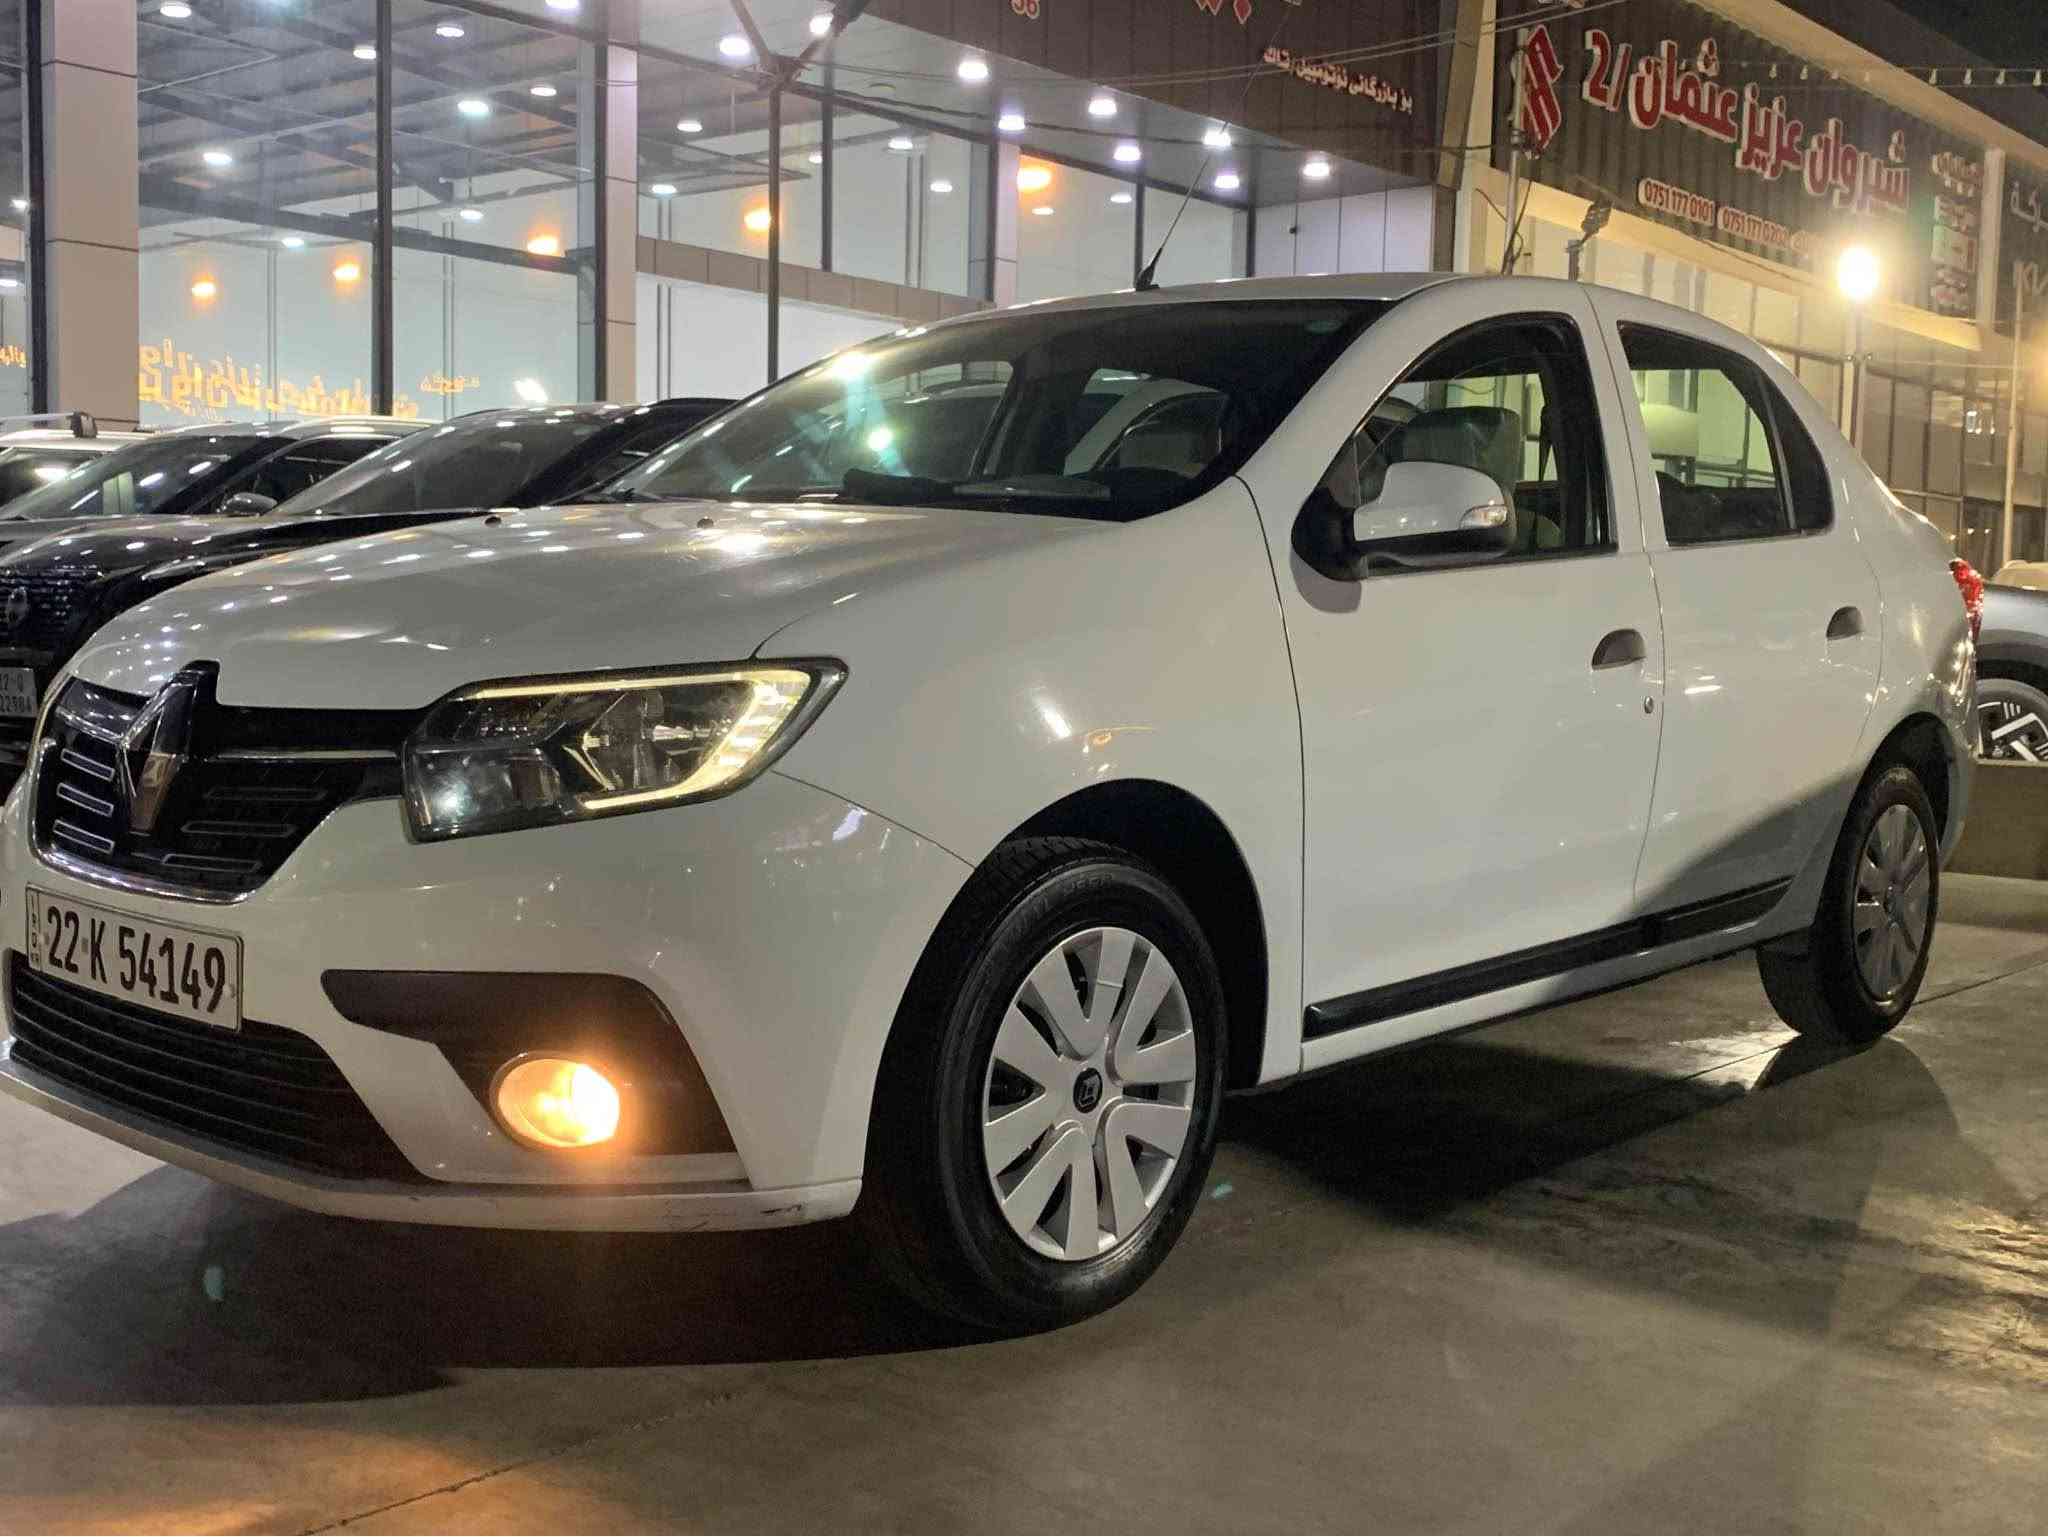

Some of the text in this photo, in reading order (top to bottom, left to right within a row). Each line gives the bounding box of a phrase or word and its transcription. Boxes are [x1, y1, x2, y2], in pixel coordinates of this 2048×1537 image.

[47, 906, 226, 1014] 22 K 54149
